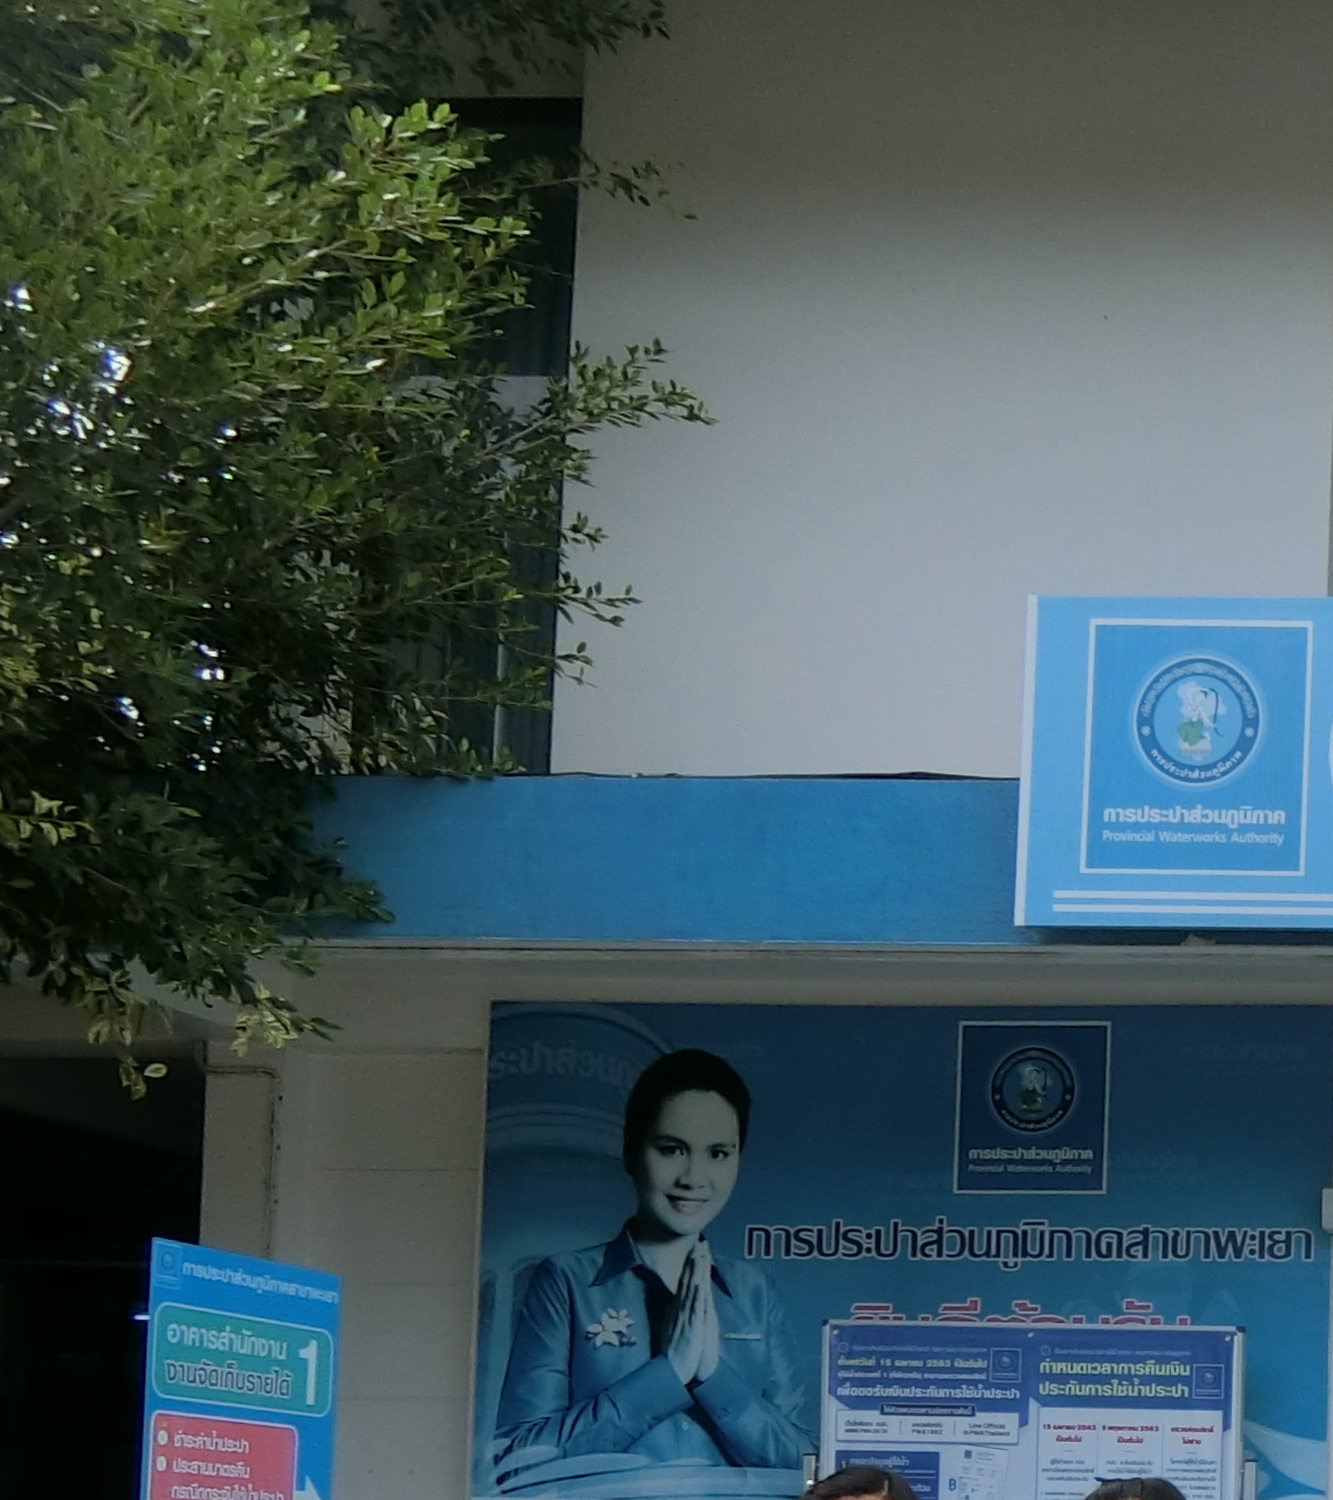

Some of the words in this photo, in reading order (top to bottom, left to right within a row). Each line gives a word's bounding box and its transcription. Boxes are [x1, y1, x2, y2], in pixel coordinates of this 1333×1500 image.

[1104, 804, 1286, 829] การประปาส่วนภูมิภาค
[1103, 830, 1155, 843] Provincial
[1159, 831, 1227, 844] Waterworks
[1231, 832, 1285, 848] Authority
[968, 1146, 1094, 1164] การประปาส่วนภูมิภาค
[745, 1216, 1315, 1271] การประปาส่วนภูมิภาคสาขาพะเยา
[182, 1261, 338, 1304] การประปาส่วนภูมิภาคสาขาพะเยา
[167, 1323, 288, 1360] อาคารสำนักงาน
[298, 1339, 318, 1406] 1
[1039, 1359, 1191, 1377] กำหนดเวลาการคืนเงิน
[165, 1359, 292, 1399] งานจัดเก็บรายได้
[837, 1381, 1020, 1399] เพื่อขอรับเงินประกันการใช้น้ำประปา
[1038, 1379, 1189, 1398] ประกันการใช้น้ำประปา
